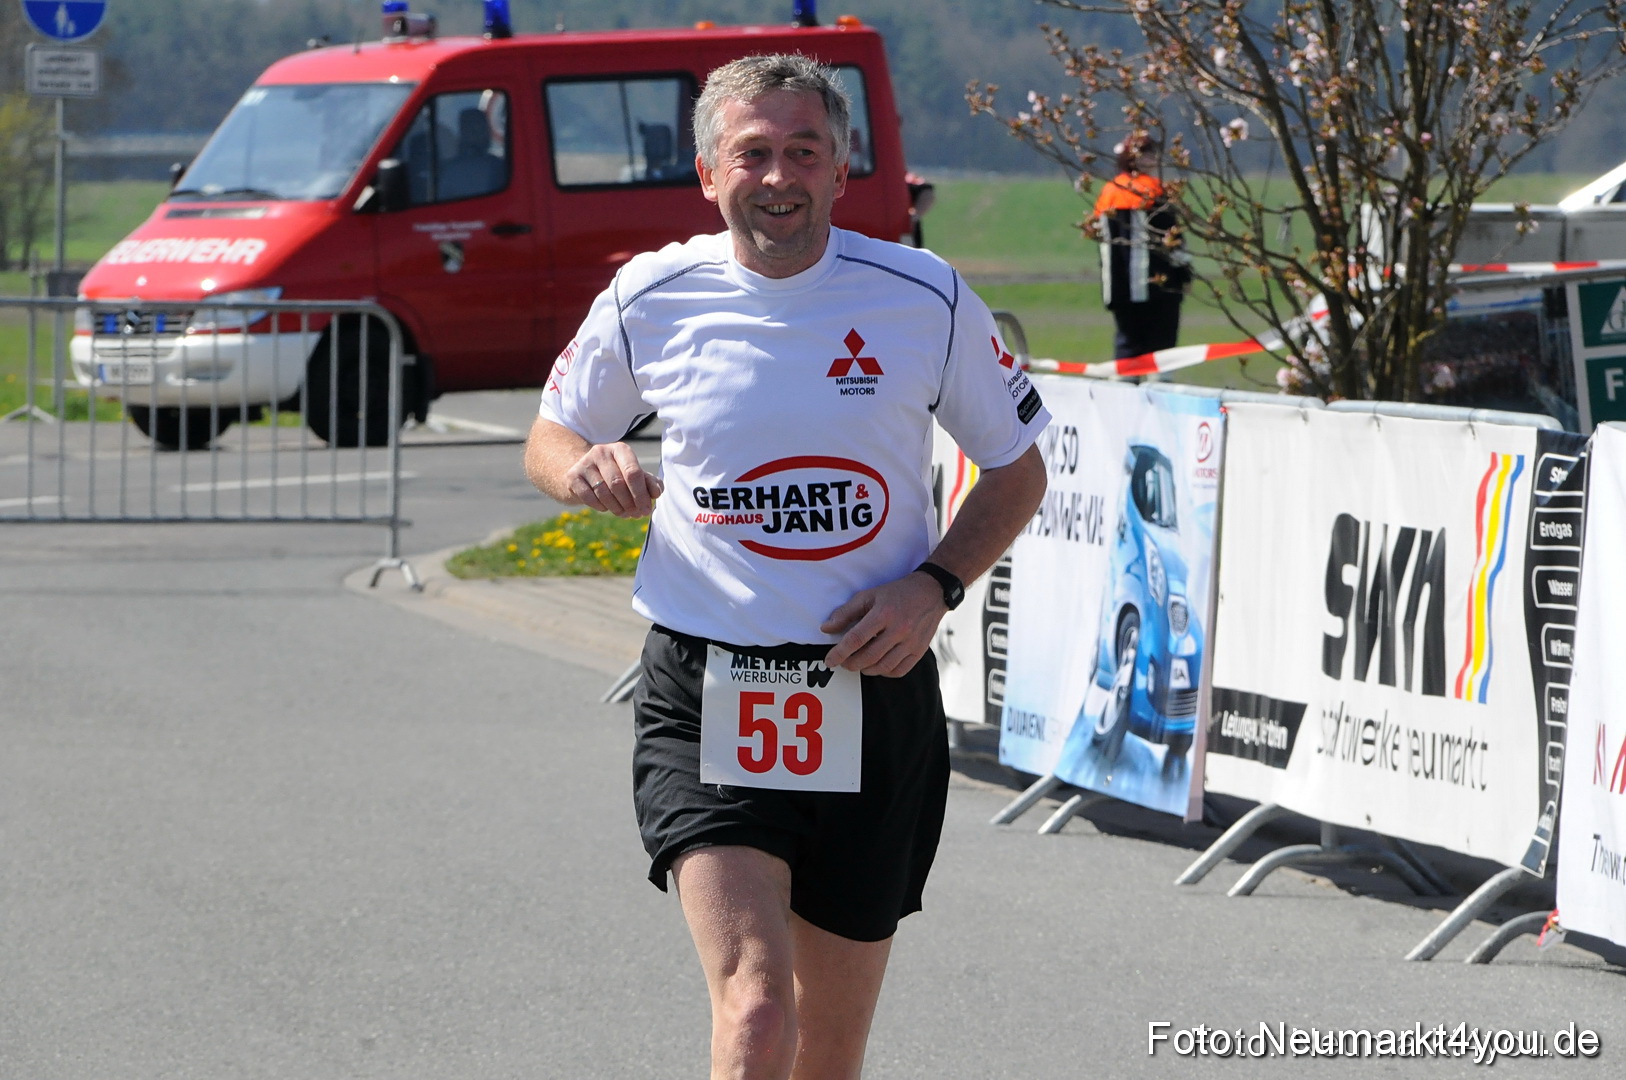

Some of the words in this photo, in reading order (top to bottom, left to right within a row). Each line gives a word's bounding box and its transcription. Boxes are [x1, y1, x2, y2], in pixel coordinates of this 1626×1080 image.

[835, 376, 878, 386] MITSUBISHI
[840, 387, 876, 396] MOTORS
[693, 480, 852, 510] GERHART
[855, 483, 870, 500] &
[695, 513, 764, 526] AUTOHAUS
[762, 503, 873, 534] JÄNIG
[1539, 521, 1573, 540] Erdgas
[730, 652, 802, 671] MEYER
[730, 670, 802, 684] WERBUNG
[737, 691, 823, 776] 53
